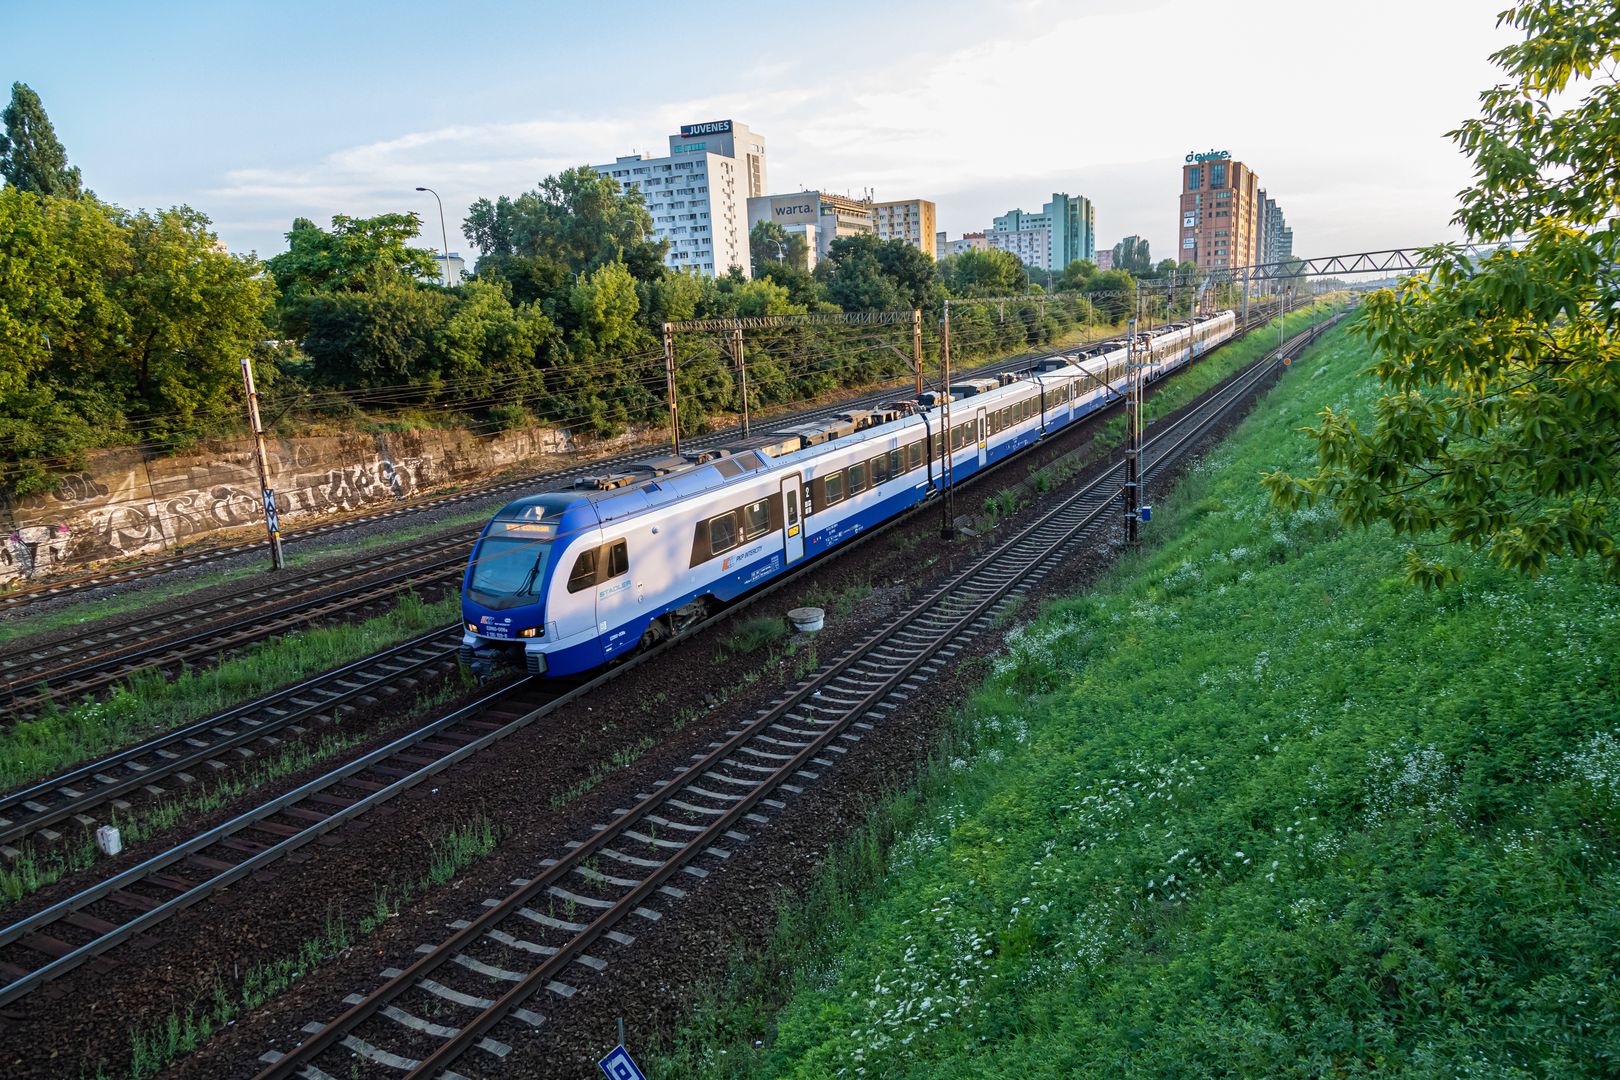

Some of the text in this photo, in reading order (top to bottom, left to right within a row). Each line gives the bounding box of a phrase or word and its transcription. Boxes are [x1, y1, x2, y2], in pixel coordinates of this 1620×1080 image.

[689, 121, 729, 135] JUVENES
[775, 204, 814, 216] warta.
[599, 580, 632, 598] STADLER
